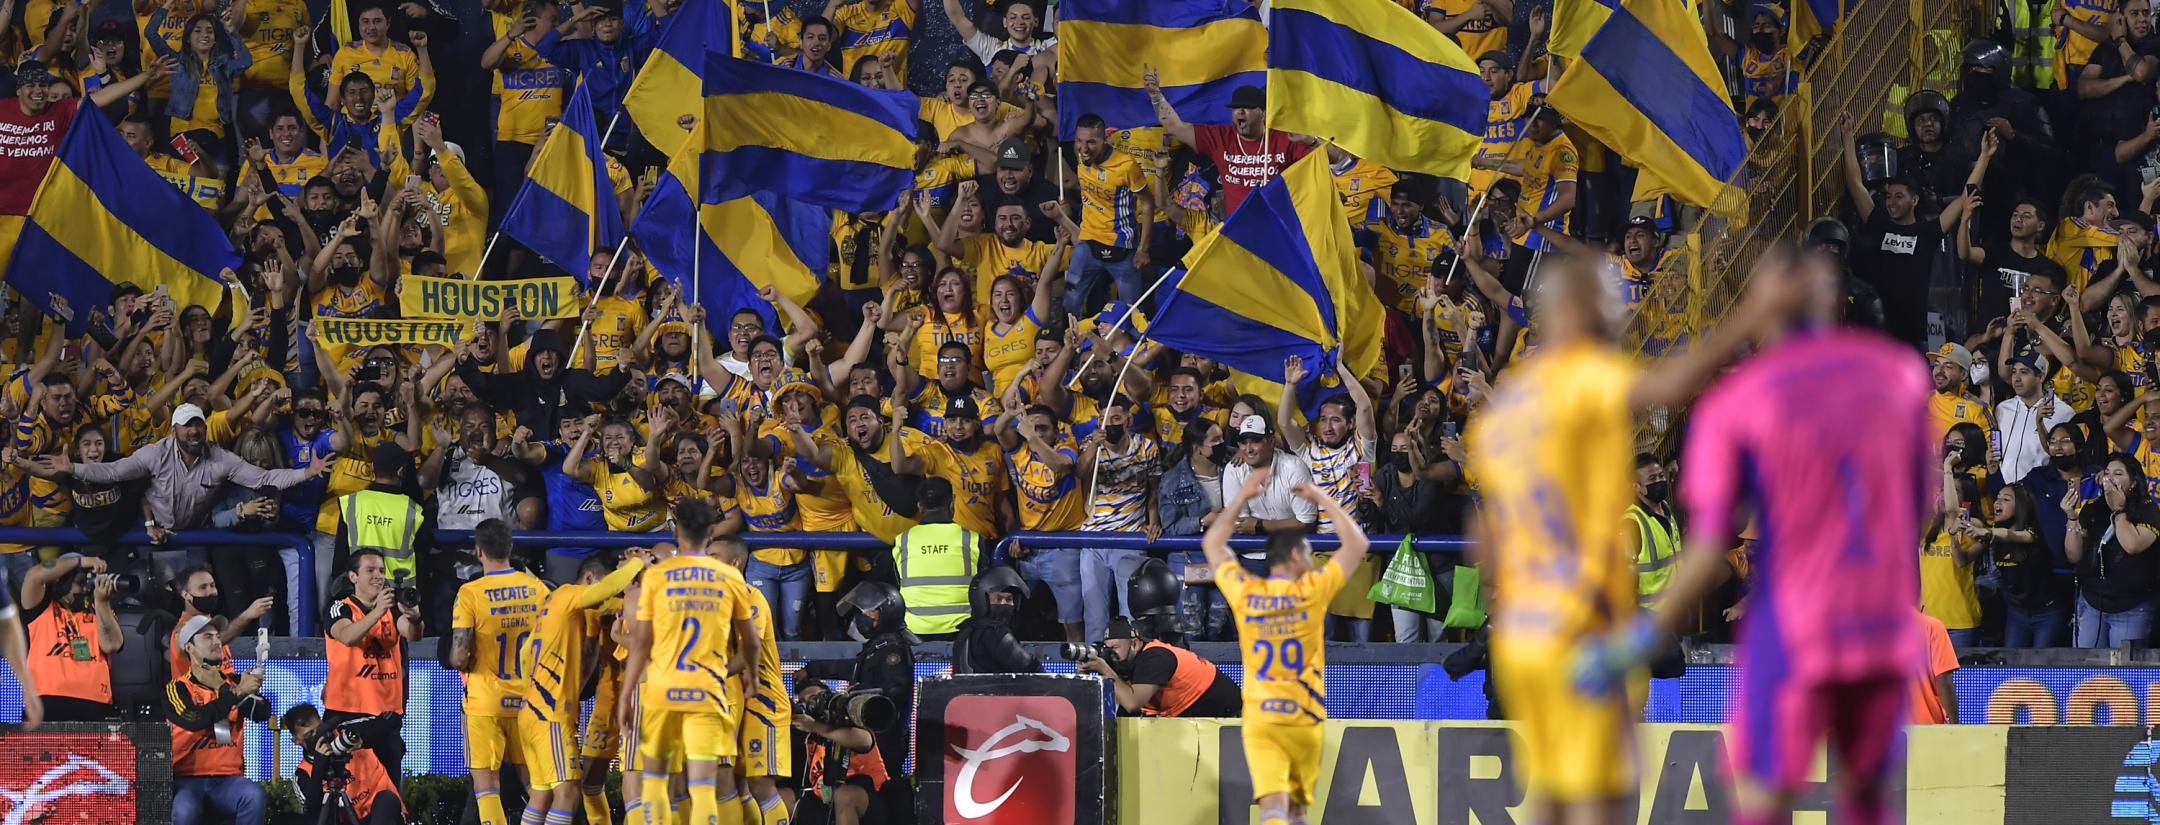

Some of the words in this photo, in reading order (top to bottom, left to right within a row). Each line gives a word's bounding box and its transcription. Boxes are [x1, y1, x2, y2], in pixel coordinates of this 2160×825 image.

[0, 120, 40, 134] UEREMOS
[42, 119, 55, 131] IR!
[1225, 175, 1241, 184] QUE
[1885, 237, 1913, 249] LEVI'S
[422, 280, 558, 318] HOUSTON
[323, 319, 464, 344] HOUSTON
[366, 514, 393, 527] STAFF
[921, 544, 949, 555] STAFF
[665, 567, 715, 582] TECATE
[485, 586, 528, 602] TECATE
[501, 618, 529, 628] GIGNAC
[676, 616, 701, 671] 2
[1253, 638, 1304, 681] 29
